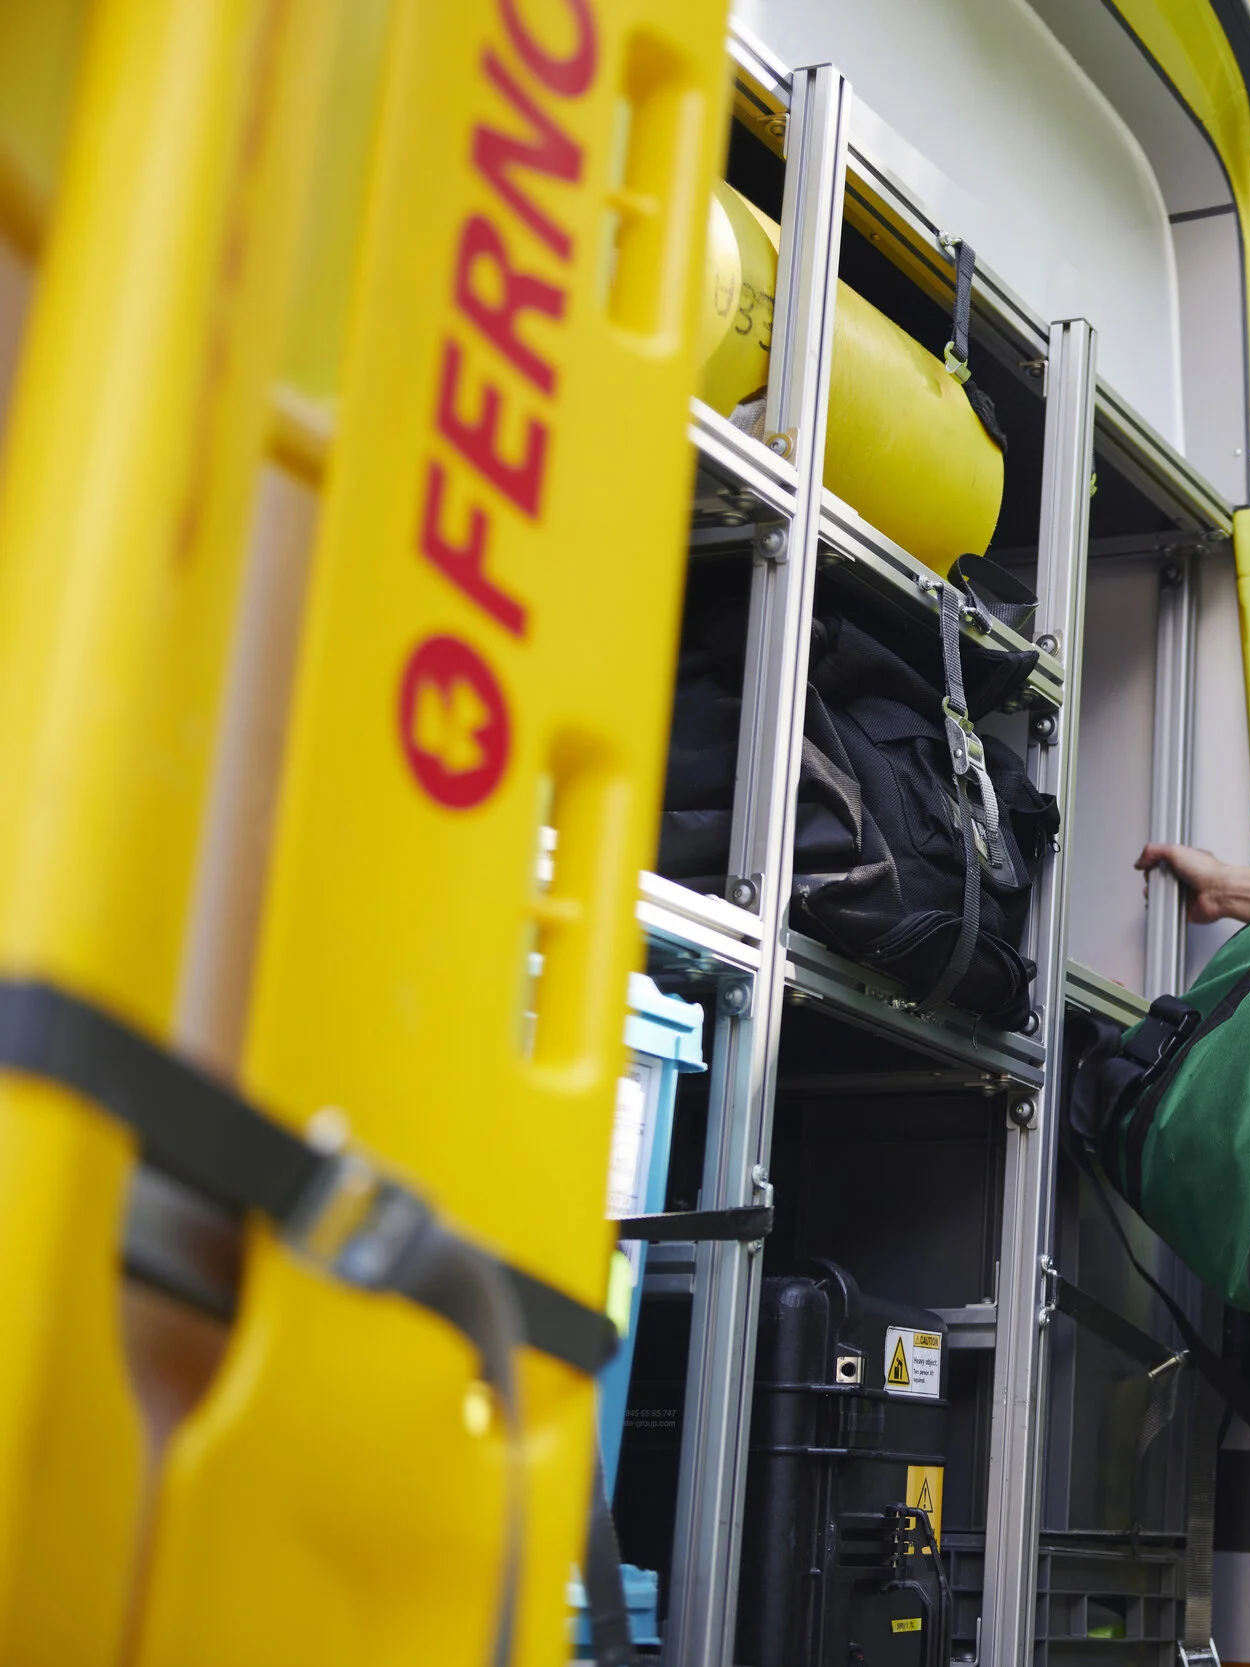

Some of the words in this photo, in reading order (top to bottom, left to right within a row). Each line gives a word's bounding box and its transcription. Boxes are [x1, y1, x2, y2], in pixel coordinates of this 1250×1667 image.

[417, 0, 602, 641] FERNO
[920, 1335, 939, 1346] CAUTION
[914, 1357, 924, 1367] Heavy
[663, 1409, 677, 1417] 747
